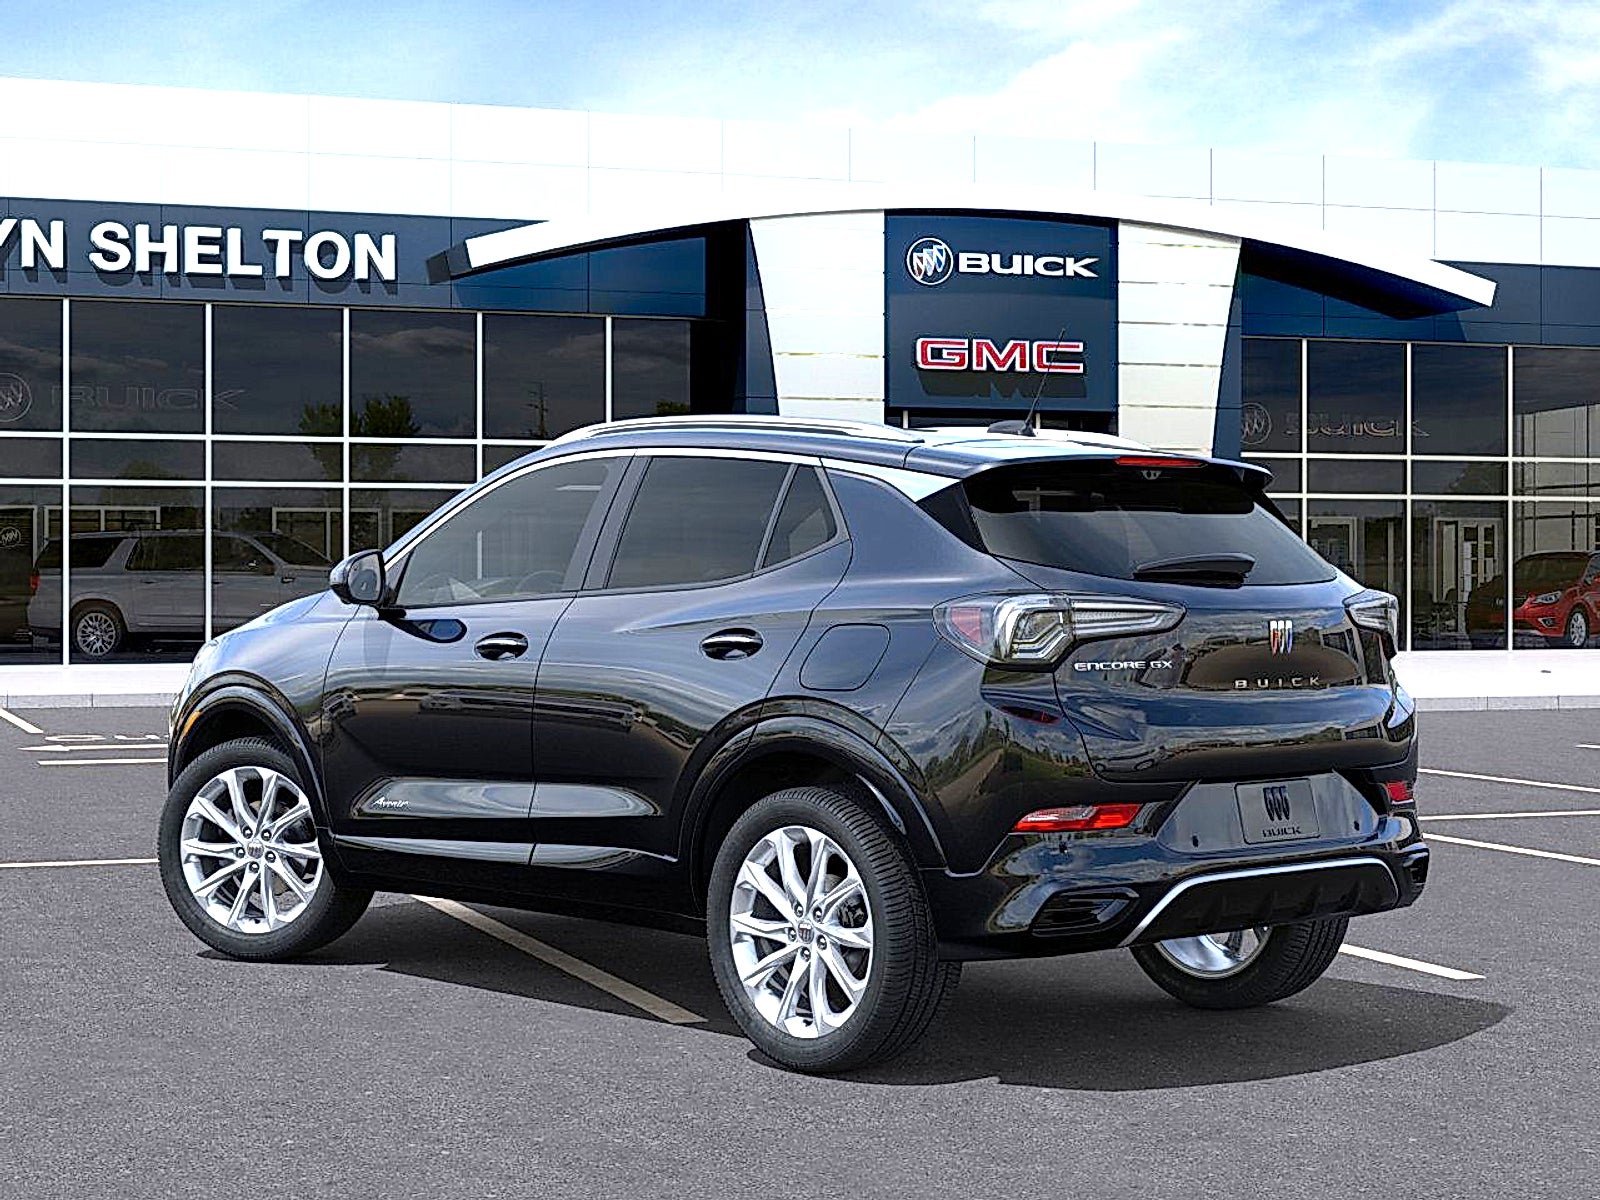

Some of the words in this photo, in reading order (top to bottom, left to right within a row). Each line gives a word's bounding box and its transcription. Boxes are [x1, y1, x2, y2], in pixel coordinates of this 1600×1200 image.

[88, 220, 397, 282] SHELTON
[958, 252, 1100, 279] BUICK
[916, 337, 1085, 374] GMC
[1074, 660, 1147, 672] ENCORE
[1150, 660, 1173, 670] GX
[1234, 676, 1321, 689] BUICK
[1262, 826, 1302, 838] BUICK
